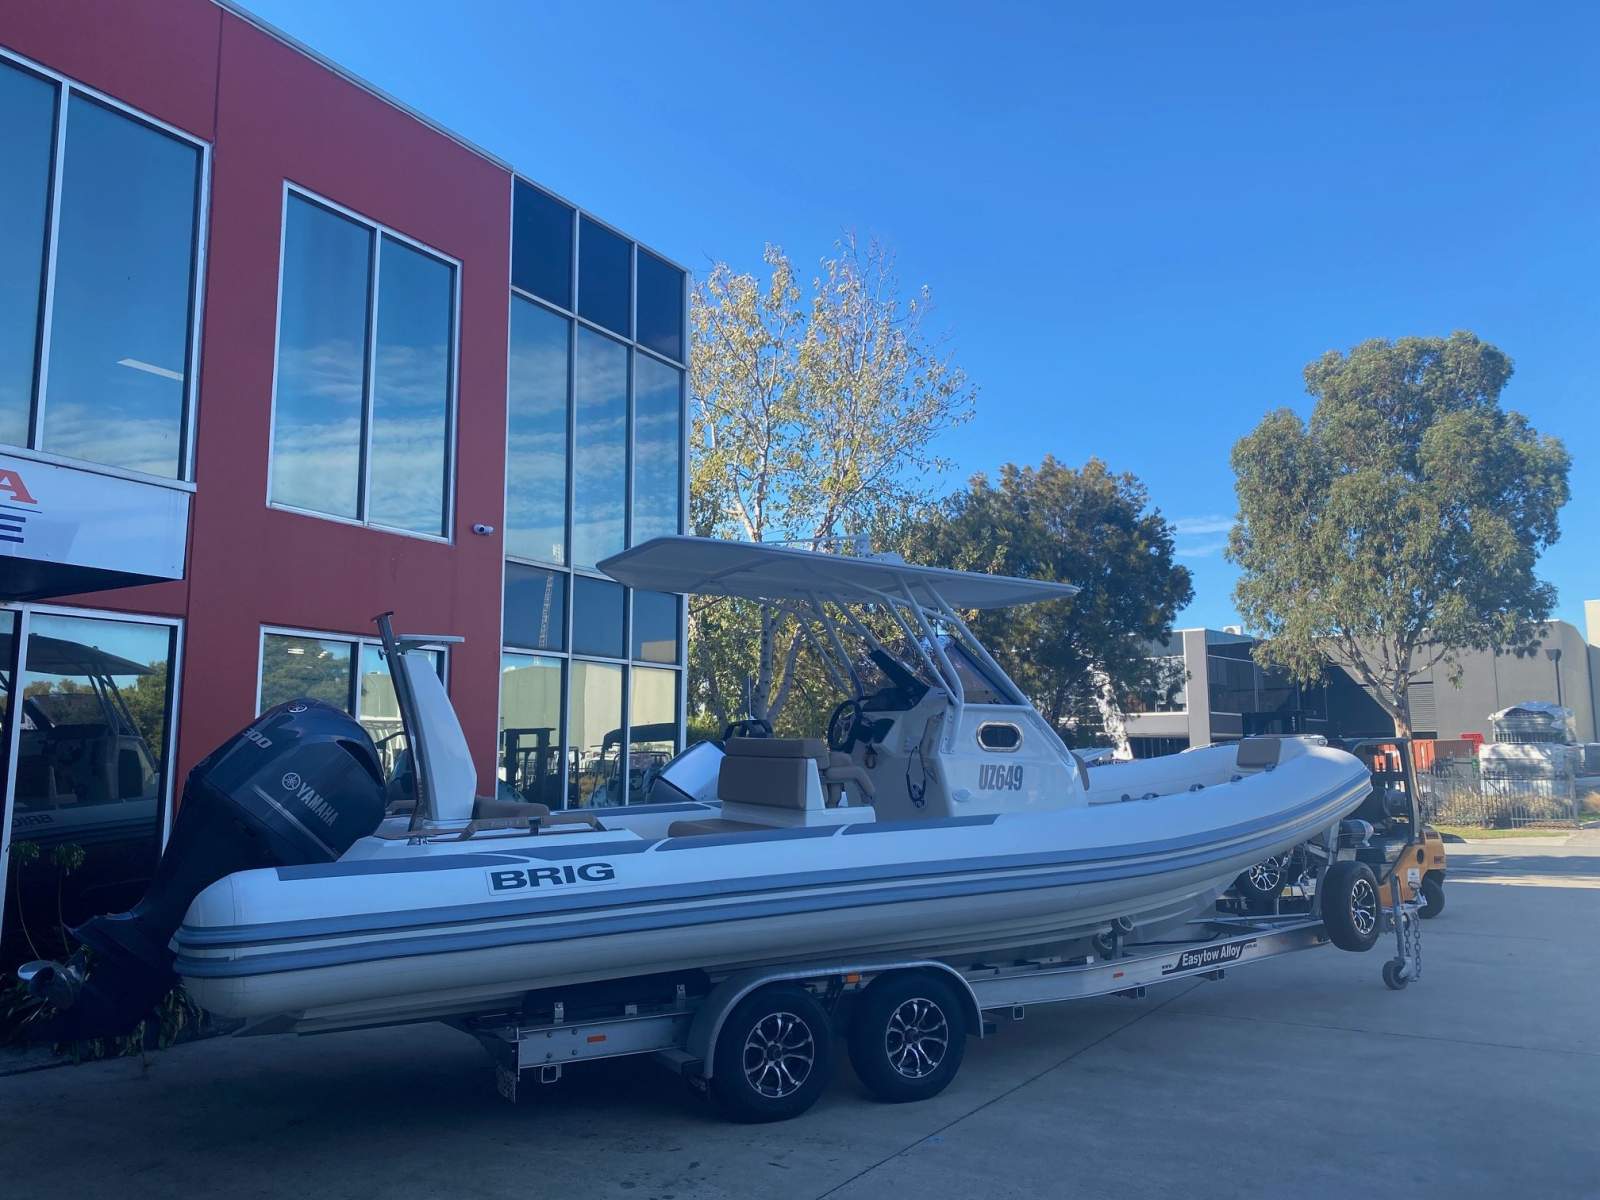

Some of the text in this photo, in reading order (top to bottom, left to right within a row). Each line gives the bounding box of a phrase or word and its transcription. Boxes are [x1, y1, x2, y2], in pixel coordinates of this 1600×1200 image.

[243, 727, 273, 749] 300
[978, 764, 1024, 791] UZ649
[296, 782, 340, 827] YAMAHA
[490, 862, 616, 891] BRIG
[1181, 949, 1220, 967] Easytow
[1220, 944, 1241, 960] Alloy
